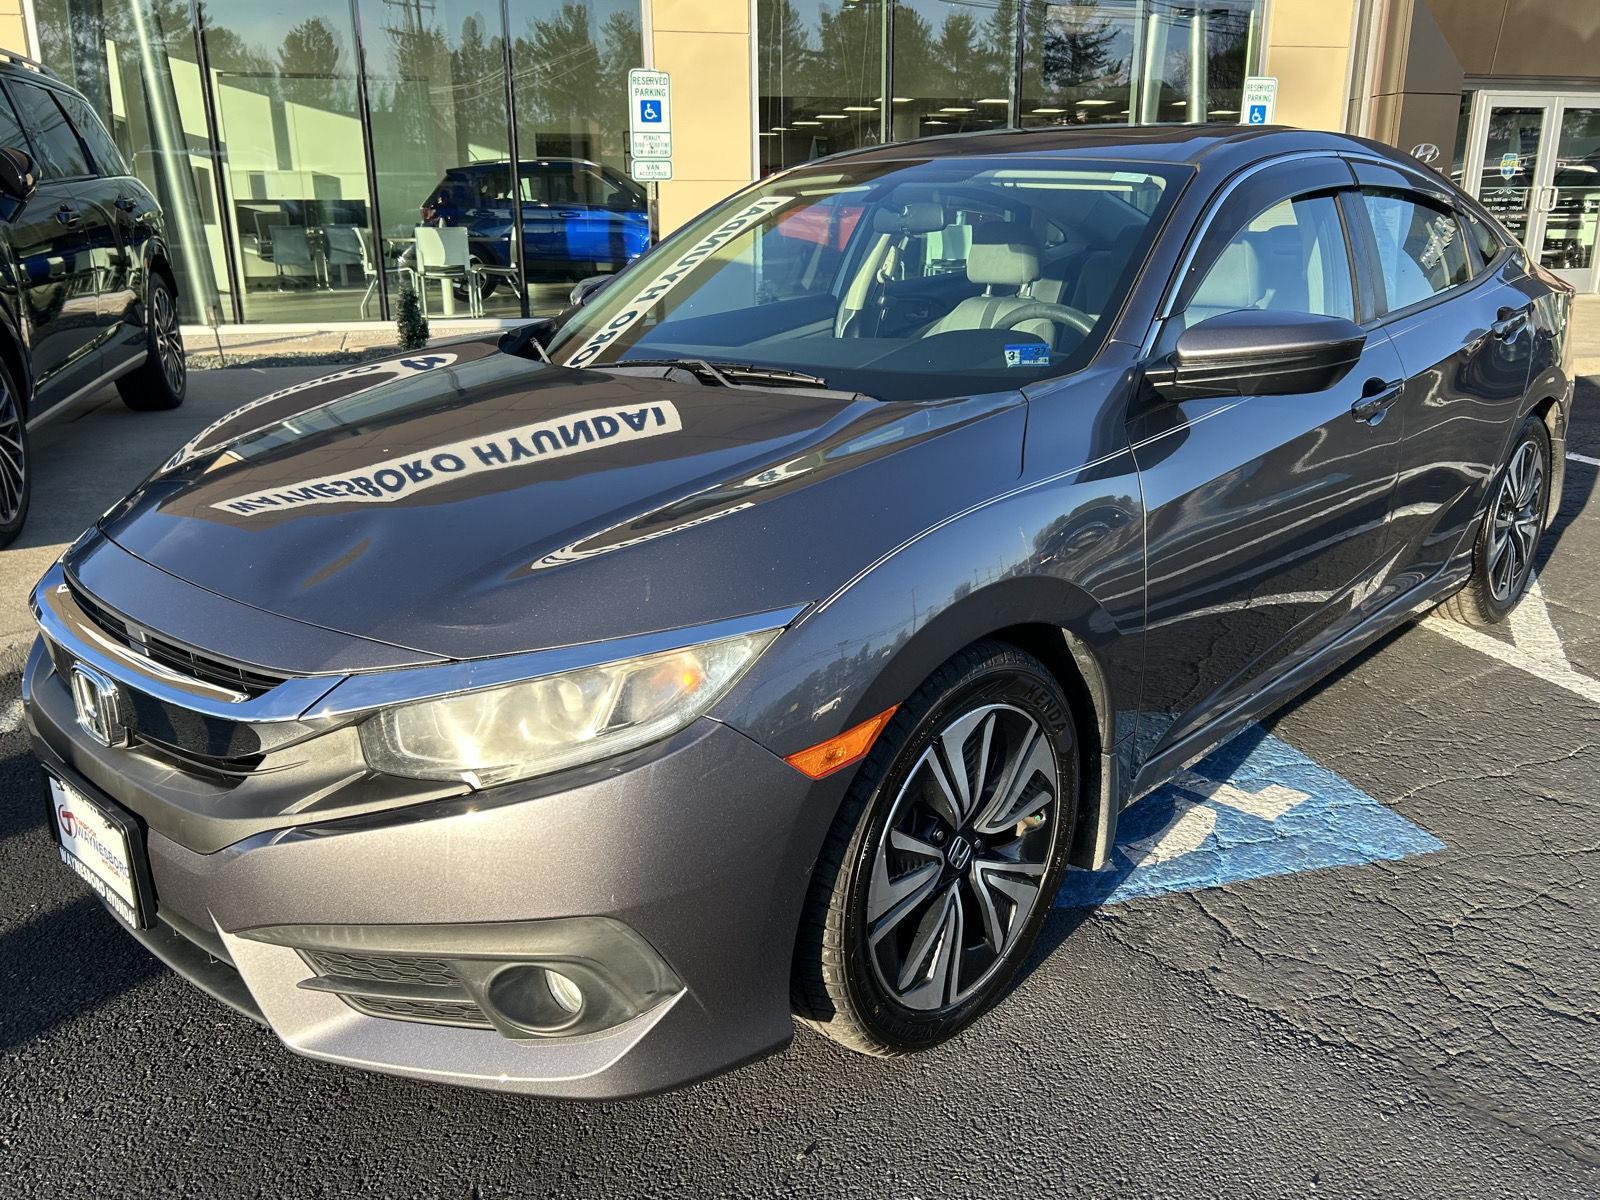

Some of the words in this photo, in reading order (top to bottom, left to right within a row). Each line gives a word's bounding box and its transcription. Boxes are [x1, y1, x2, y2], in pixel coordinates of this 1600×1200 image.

[632, 76, 668, 86] RESERVED
[634, 87, 667, 97] PARKING
[1246, 84, 1275, 92] RESERVED
[1247, 94, 1272, 102] PARKING
[1008, 351, 1015, 360] 3
[1022, 682, 1067, 736] KENDA
[77, 826, 130, 879] WAYNESBORO
[58, 846, 107, 899] WAYNESBORO
[105, 886, 138, 930] HYUNDAI
